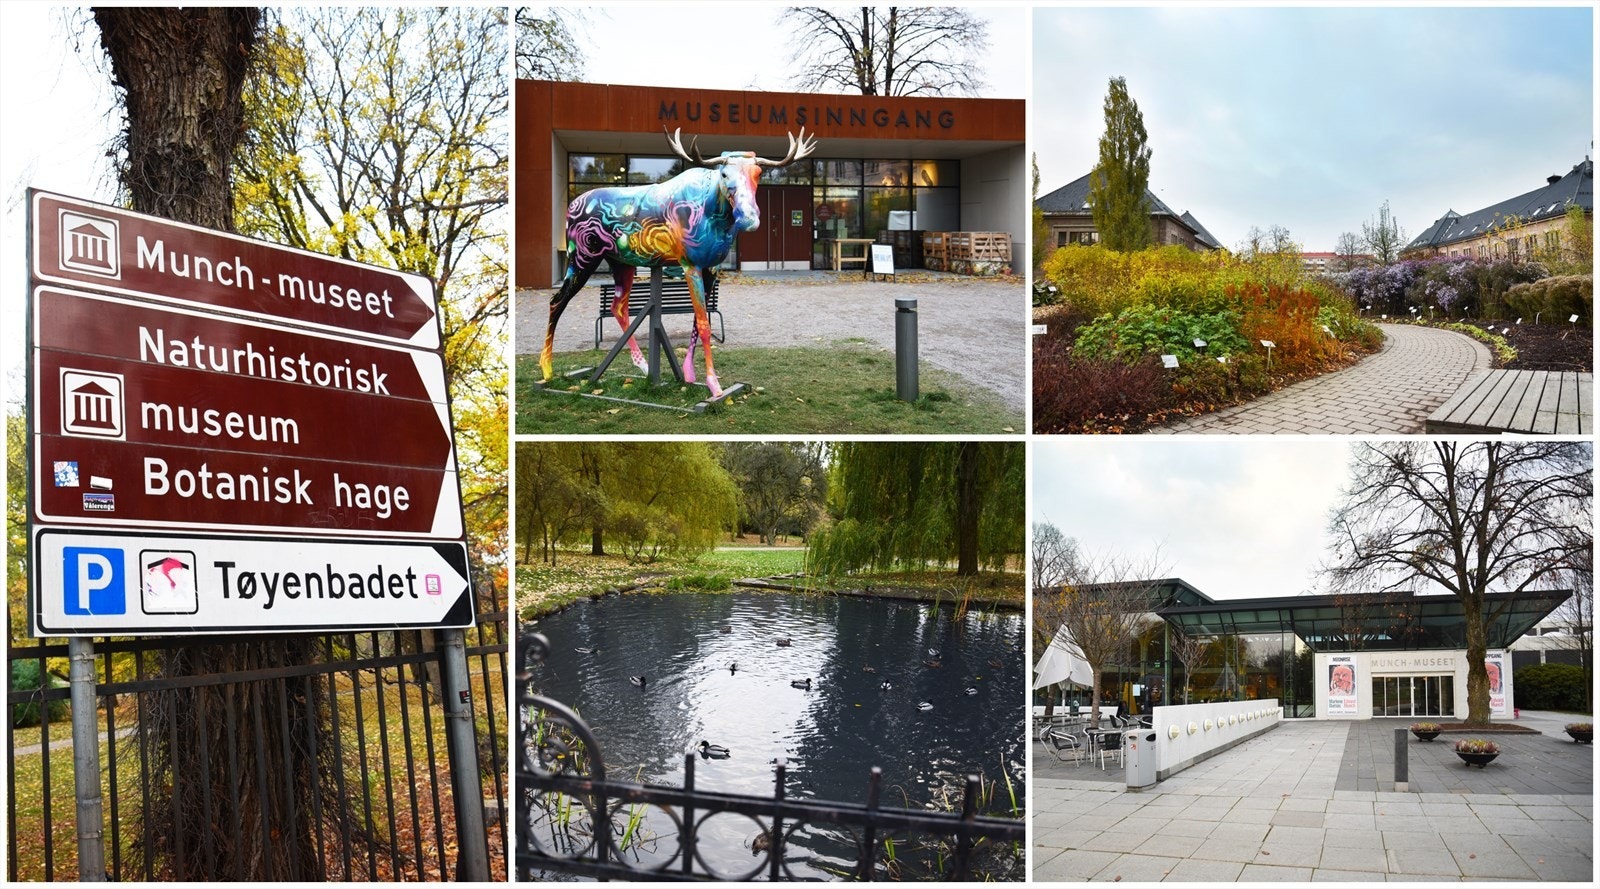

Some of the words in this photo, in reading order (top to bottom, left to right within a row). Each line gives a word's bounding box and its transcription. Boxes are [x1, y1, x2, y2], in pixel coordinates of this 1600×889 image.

[657, 99, 957, 130] MUSEUMSINNGANG
[139, 326, 391, 396] Naturhistorisk
[142, 402, 300, 445] museum
[144, 457, 313, 505] Botanisk
[334, 473, 410, 518] hage
[78, 554, 113, 612] P
[214, 562, 419, 610] Tøyenbadet
